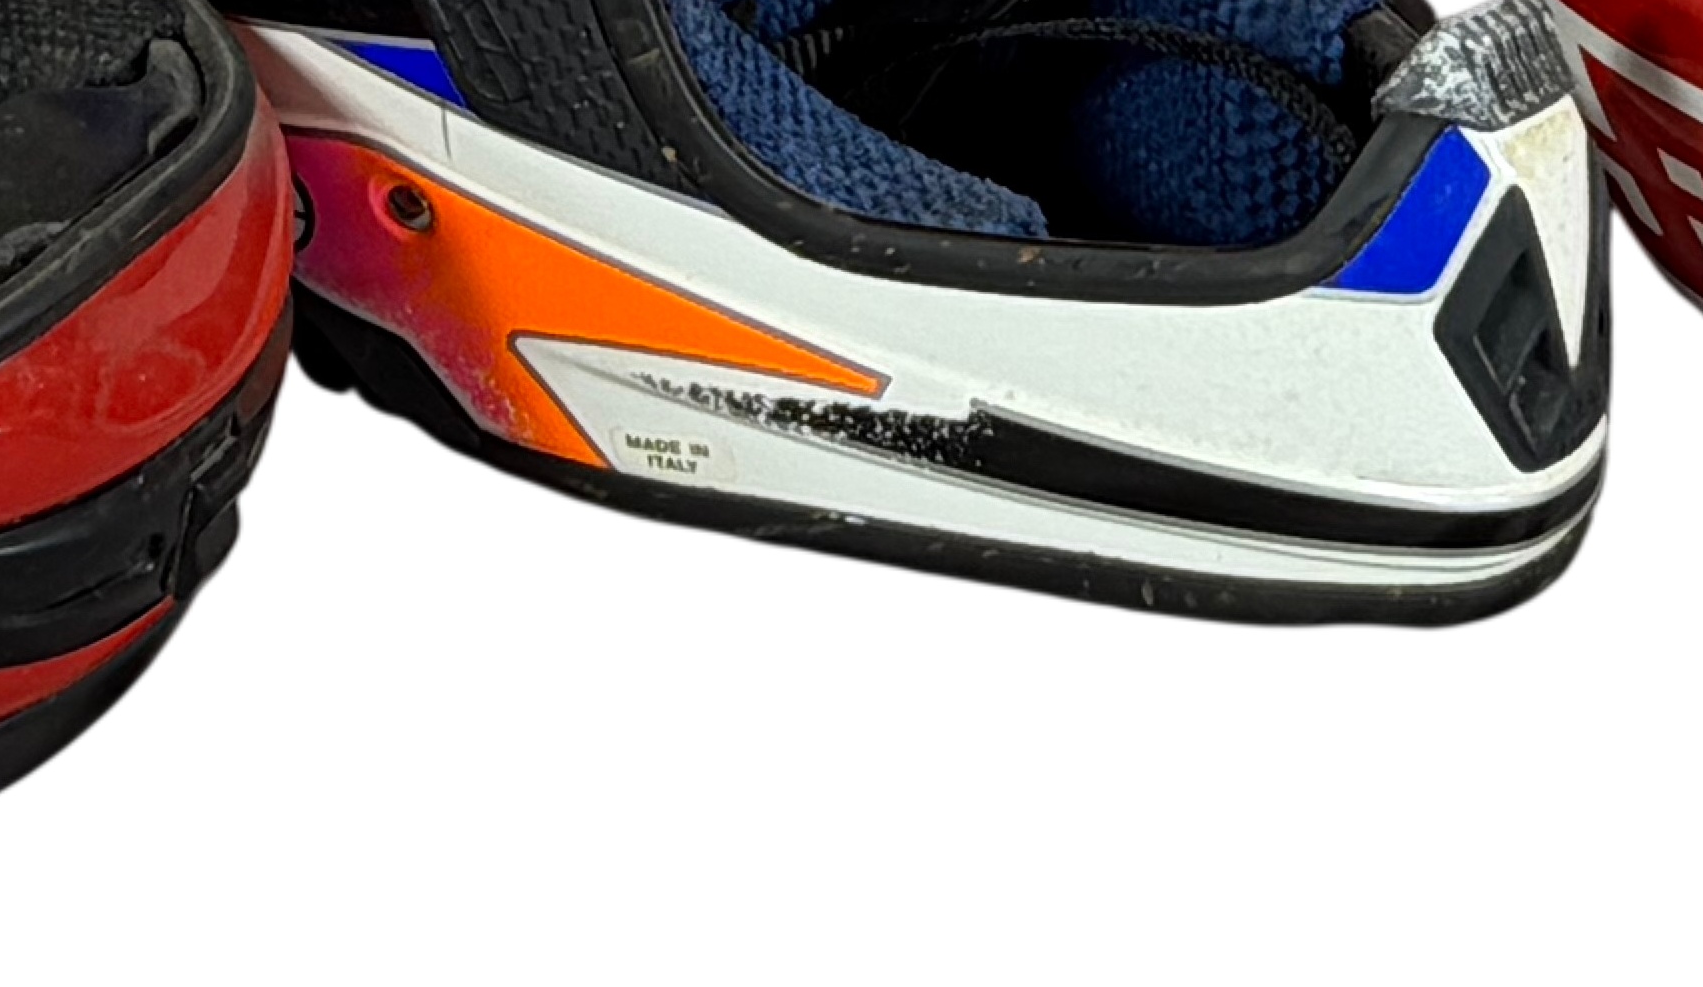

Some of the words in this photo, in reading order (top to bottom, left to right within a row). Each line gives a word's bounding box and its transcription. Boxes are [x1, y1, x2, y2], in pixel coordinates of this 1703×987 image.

[624, 433, 681, 455] MADE
[689, 443, 710, 458] IN
[647, 455, 698, 474] ITALY
